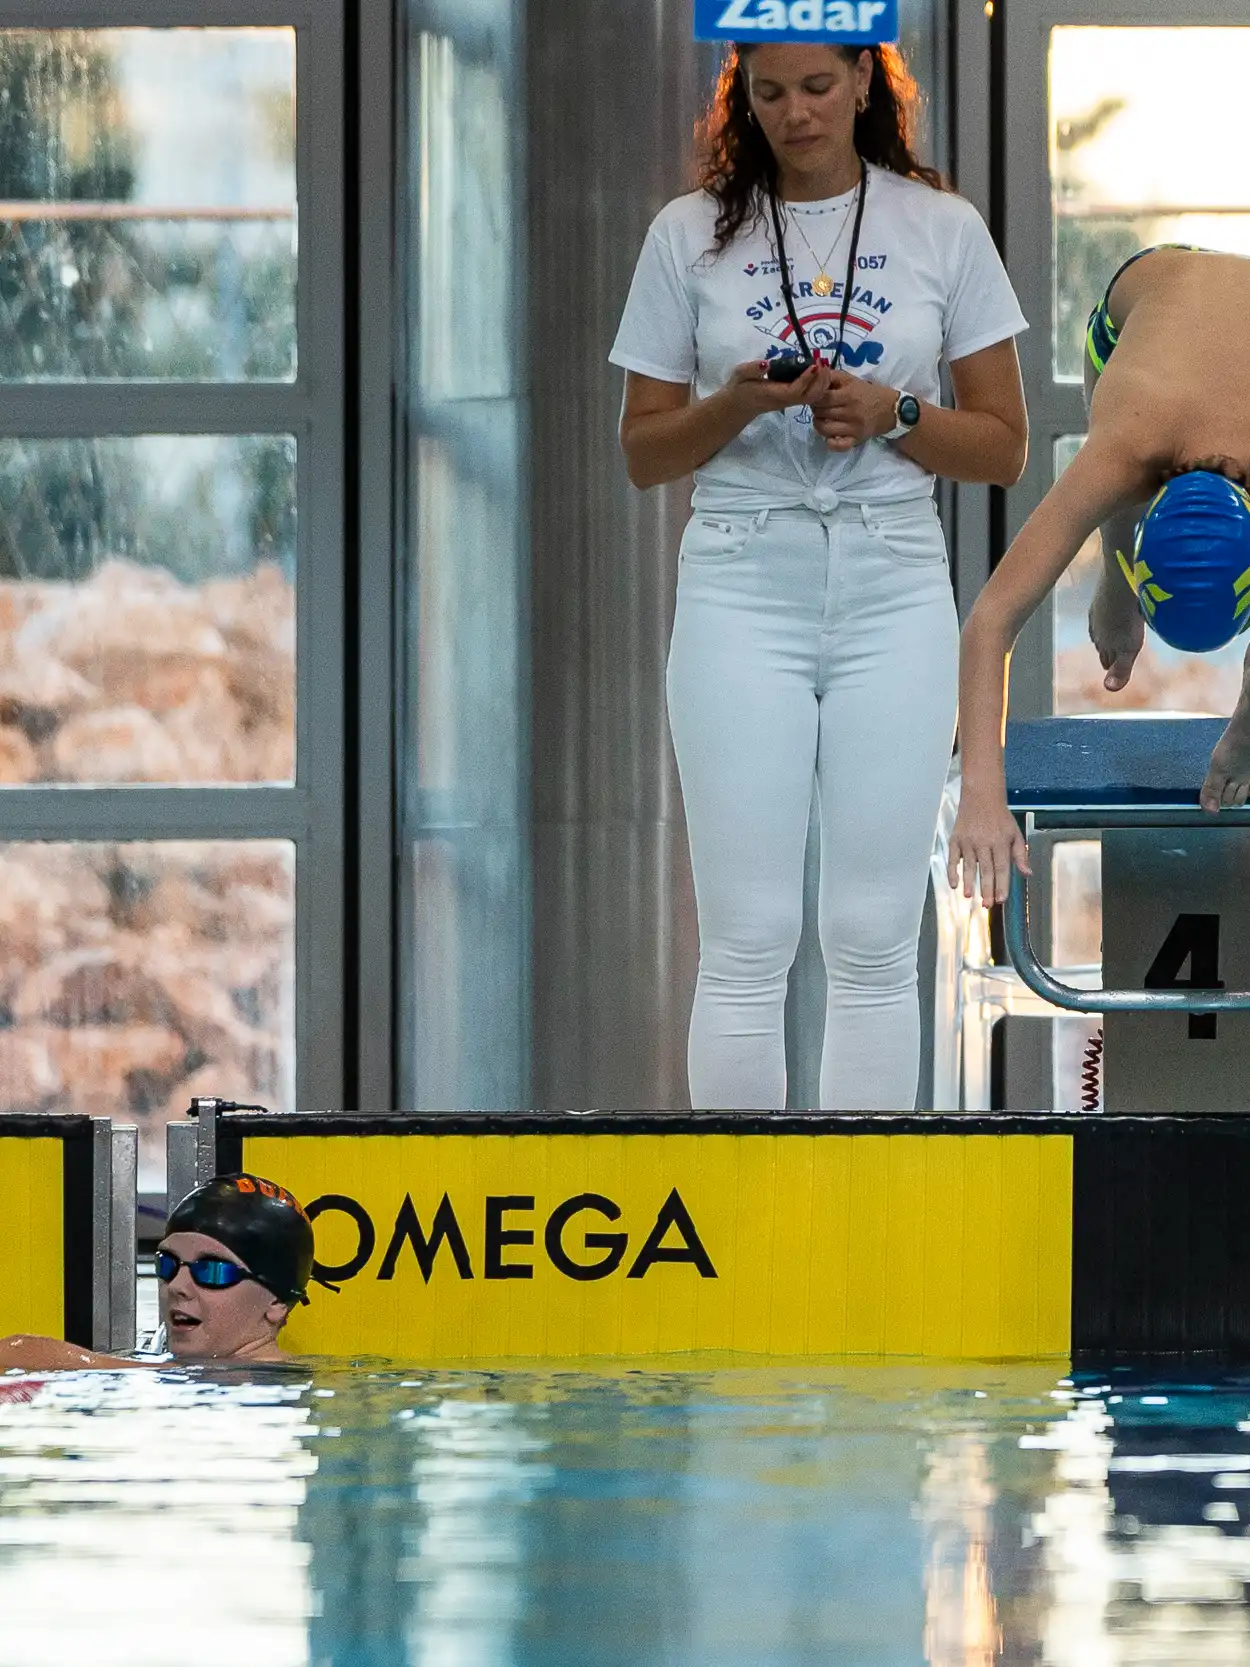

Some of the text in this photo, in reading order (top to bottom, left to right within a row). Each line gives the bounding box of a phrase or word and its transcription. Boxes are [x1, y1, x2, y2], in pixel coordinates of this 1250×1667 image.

[715, 0, 887, 31] Zadar
[857, 255, 887, 270] 057
[746, 296, 781, 320] SV.
[1144, 913, 1225, 1040] 4
[301, 1186, 719, 1285] OMEGA
